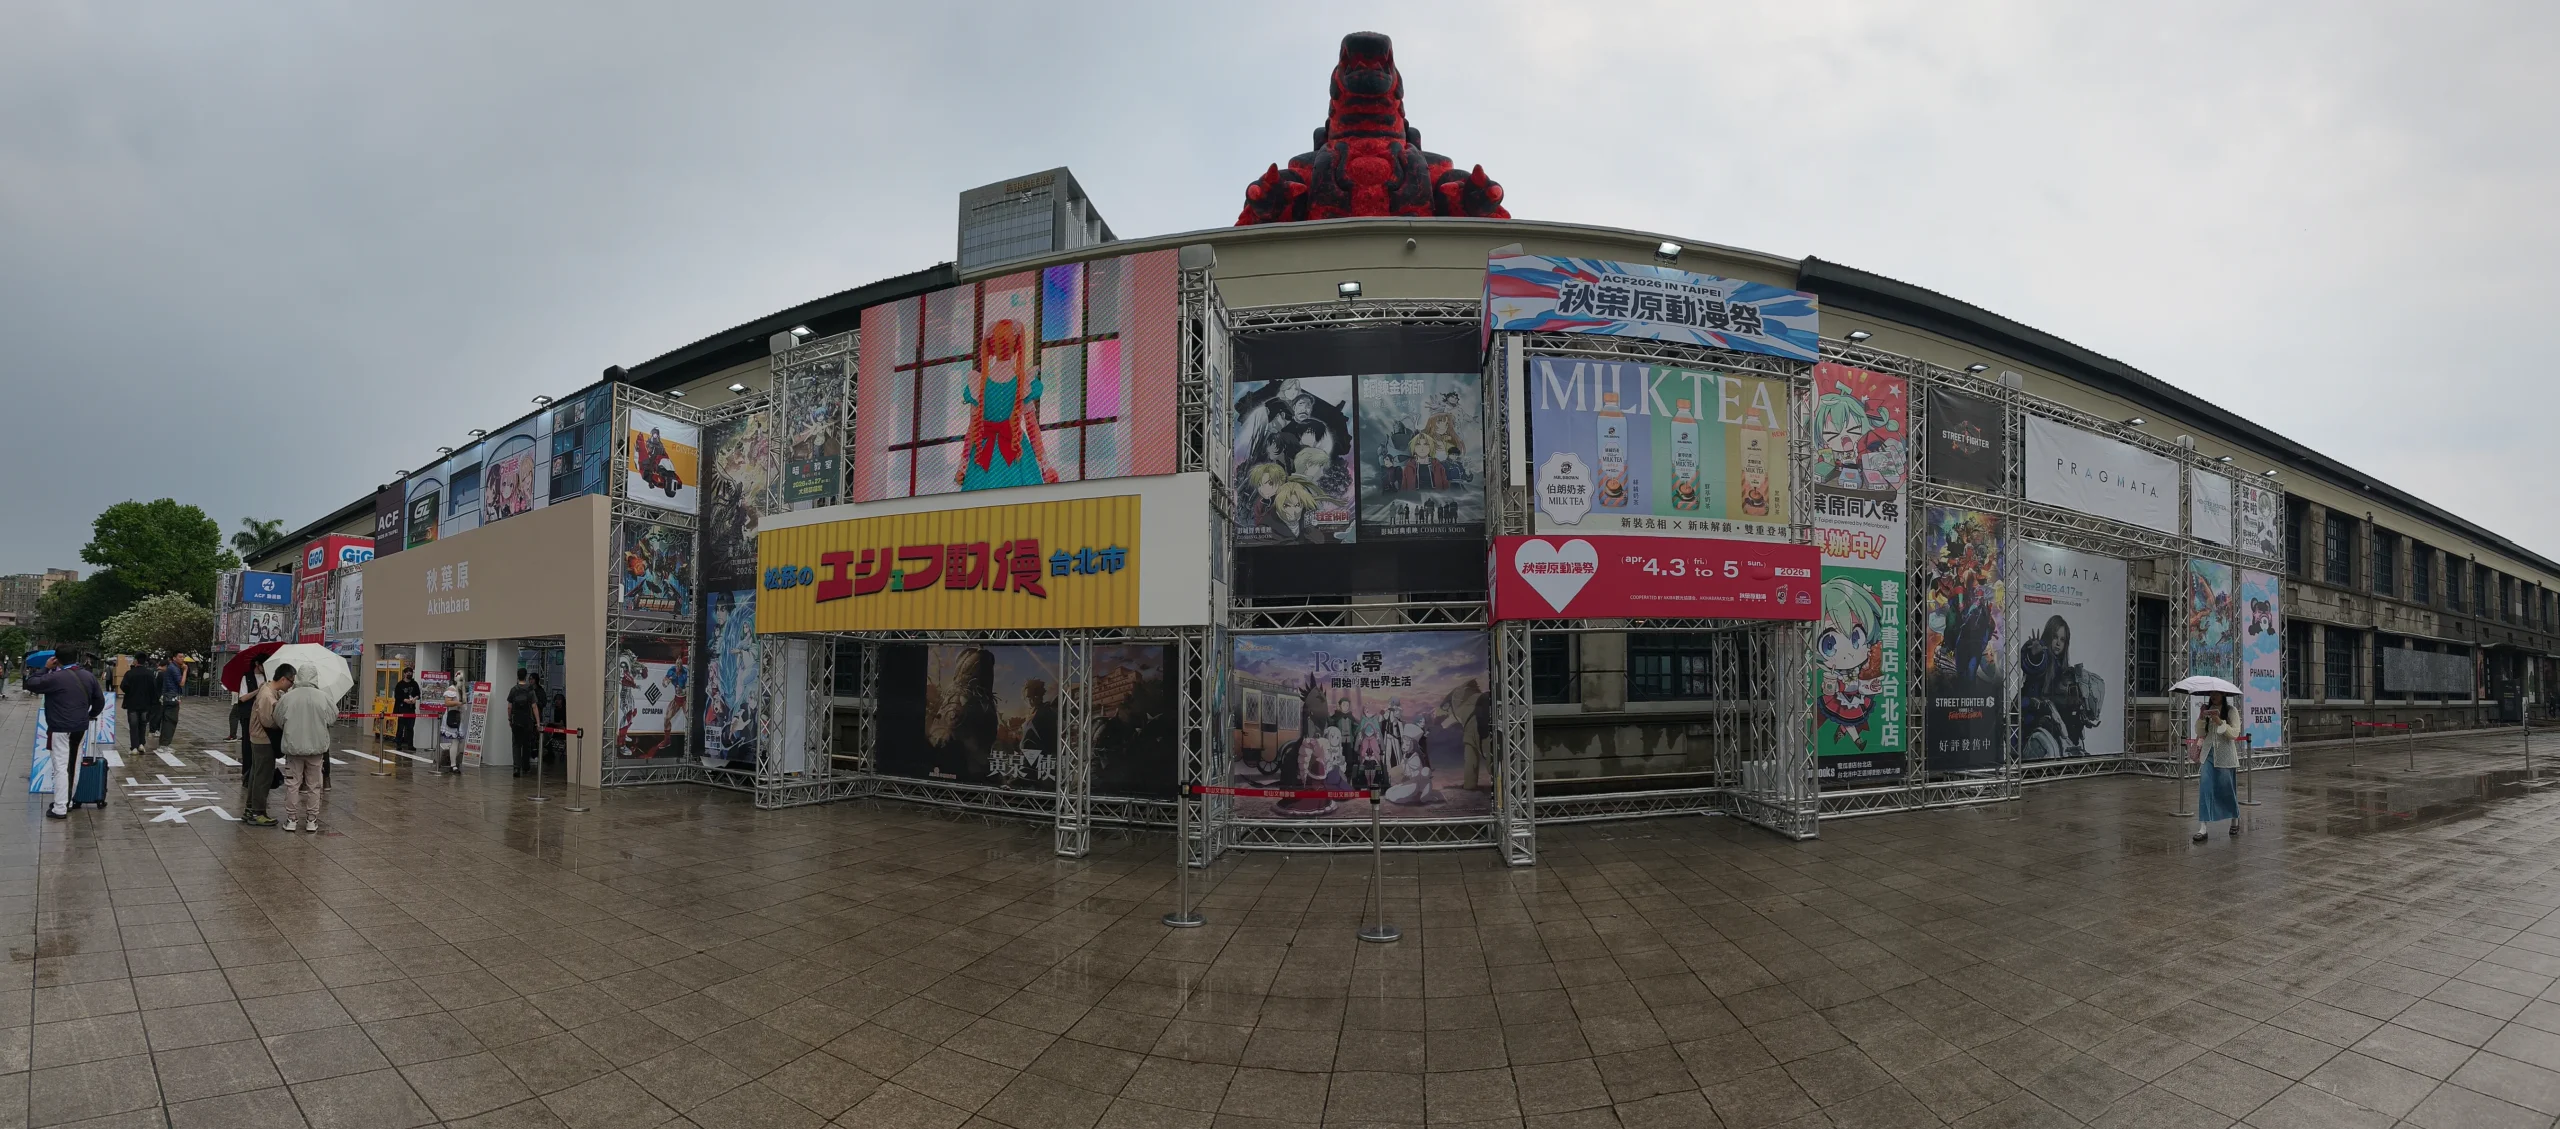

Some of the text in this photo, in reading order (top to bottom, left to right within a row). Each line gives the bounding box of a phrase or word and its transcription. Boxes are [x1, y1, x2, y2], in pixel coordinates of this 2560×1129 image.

[1602, 274, 1721, 297] ACF2026 IN TAIPEI
[1560, 282, 1764, 336] 秋葉原動漫祭
[1540, 360, 1781, 430] MILK TEA
[1942, 430, 1990, 449] STREET FIGHTER
[1546, 484, 1586, 495] 伯朗奶茶
[1548, 496, 1585, 506] MILK TEA
[1805, 492, 1899, 523] 葉原同人祭
[377, 509, 399, 532] ACF
[1621, 517, 1668, 530] 新裝亮相
[426, 560, 470, 594] 秋葉原
[763, 564, 814, 591] 松菸の
[1048, 545, 1128, 577] 台北市
[1522, 562, 1595, 575] 秋葉原動漫祭
[1642, 558, 1686, 577] 4.3
[1694, 567, 1714, 577] to
[1723, 560, 1740, 578] 5
[2035, 582, 2076, 596] 2026.4.17
[427, 596, 470, 616] Akihabara
[1312, 650, 1383, 673] Re: 從零
[1880, 579, 1900, 748] 蜜瓜書店台北店
[1331, 675, 1412, 689] 開始的異世界生活
[1935, 697, 1960, 707] STREET
[1960, 697, 1985, 707] FIGHTER
[2250, 706, 2276, 715] PHANTA
[2255, 715, 2272, 724] BEAR
[121, 774, 243, 823] 止まれ
